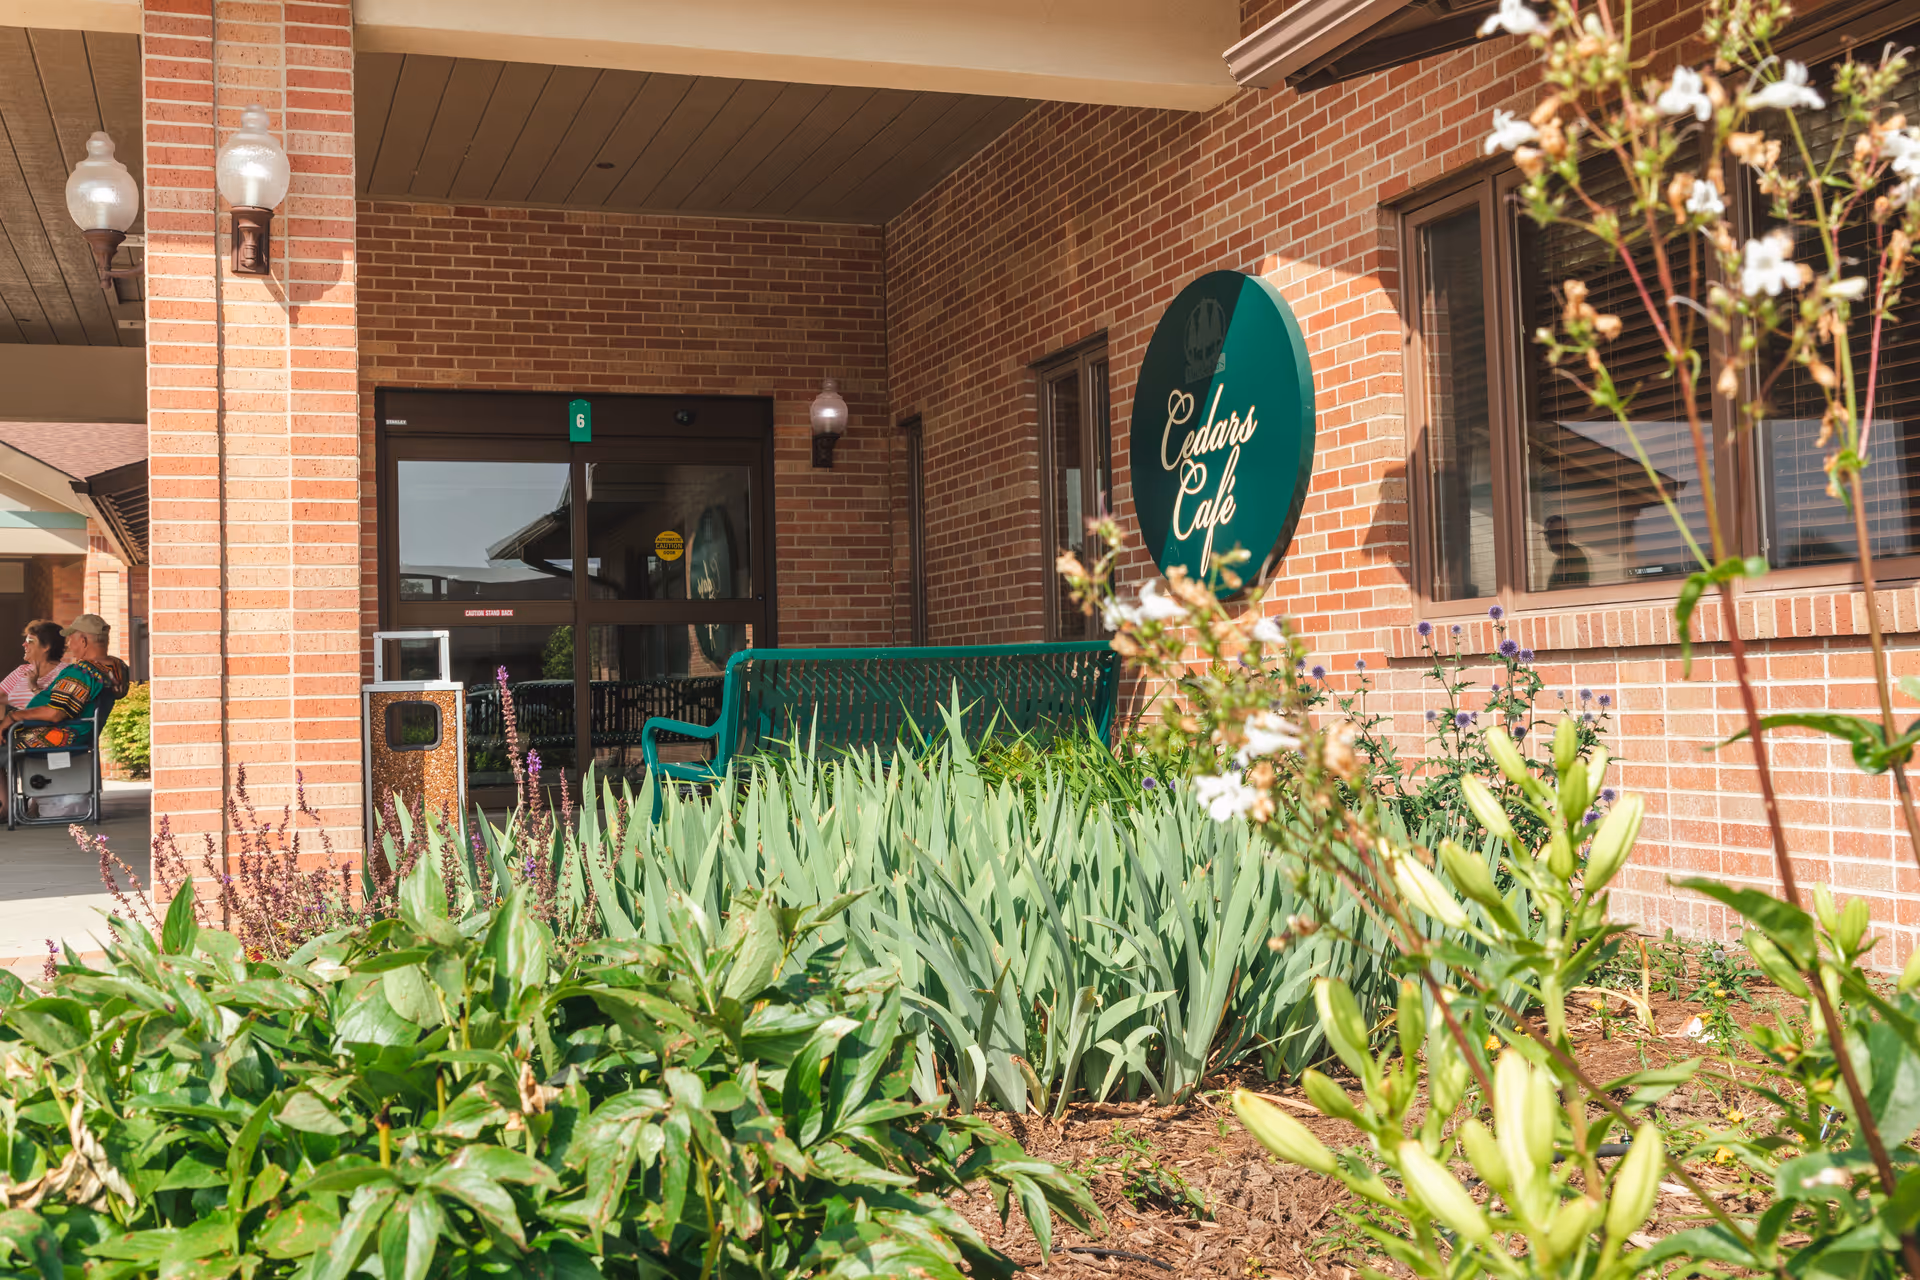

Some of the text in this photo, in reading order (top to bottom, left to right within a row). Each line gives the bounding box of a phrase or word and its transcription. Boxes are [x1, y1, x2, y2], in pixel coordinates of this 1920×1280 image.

[576, 413, 585, 428] 6
[1161, 383, 1258, 470] Cedars
[501, 609, 513, 617] BACK
